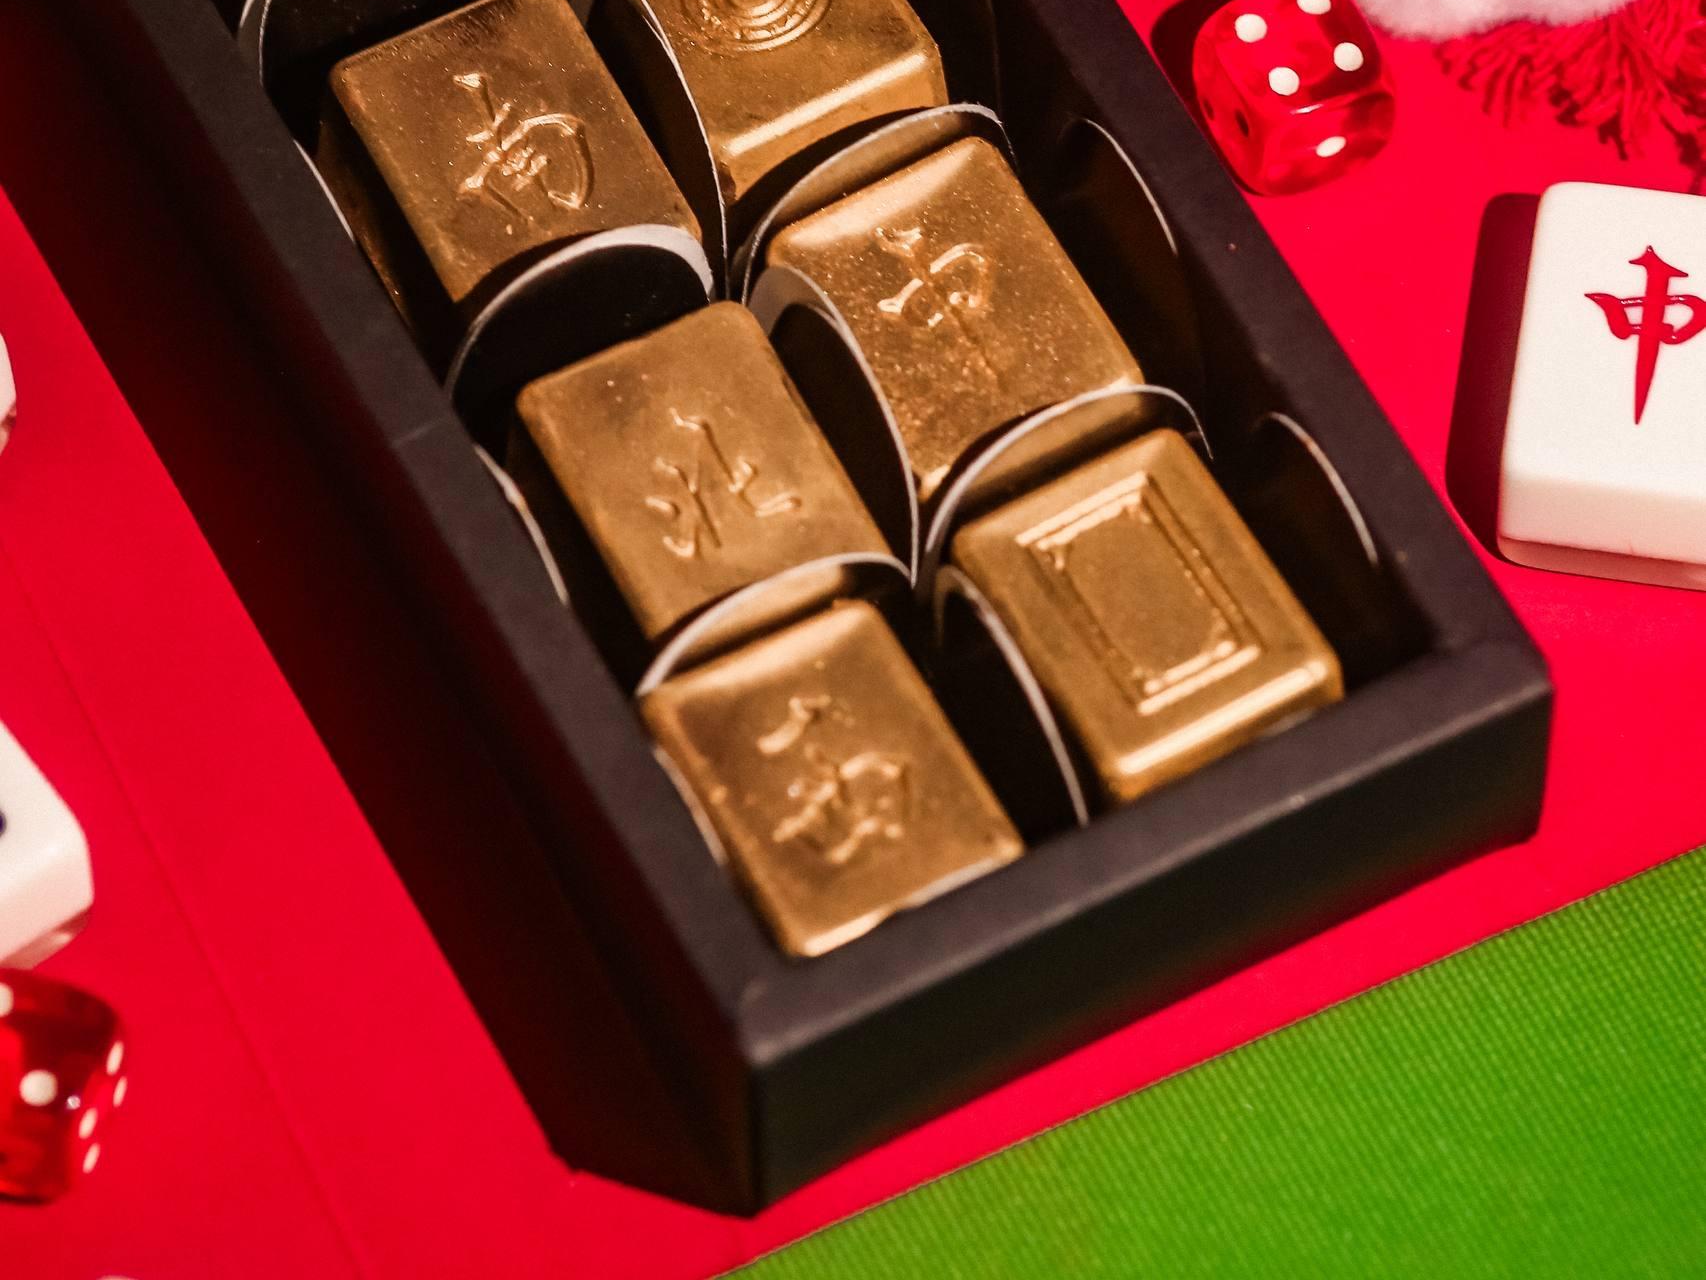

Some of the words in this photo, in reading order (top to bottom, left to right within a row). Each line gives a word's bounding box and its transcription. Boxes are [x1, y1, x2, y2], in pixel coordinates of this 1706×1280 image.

[453, 72, 596, 223] 南
[874, 226, 996, 380] 中
[1583, 244, 1706, 425] 中
[645, 406, 802, 558] 北
[757, 694, 914, 864] 西
